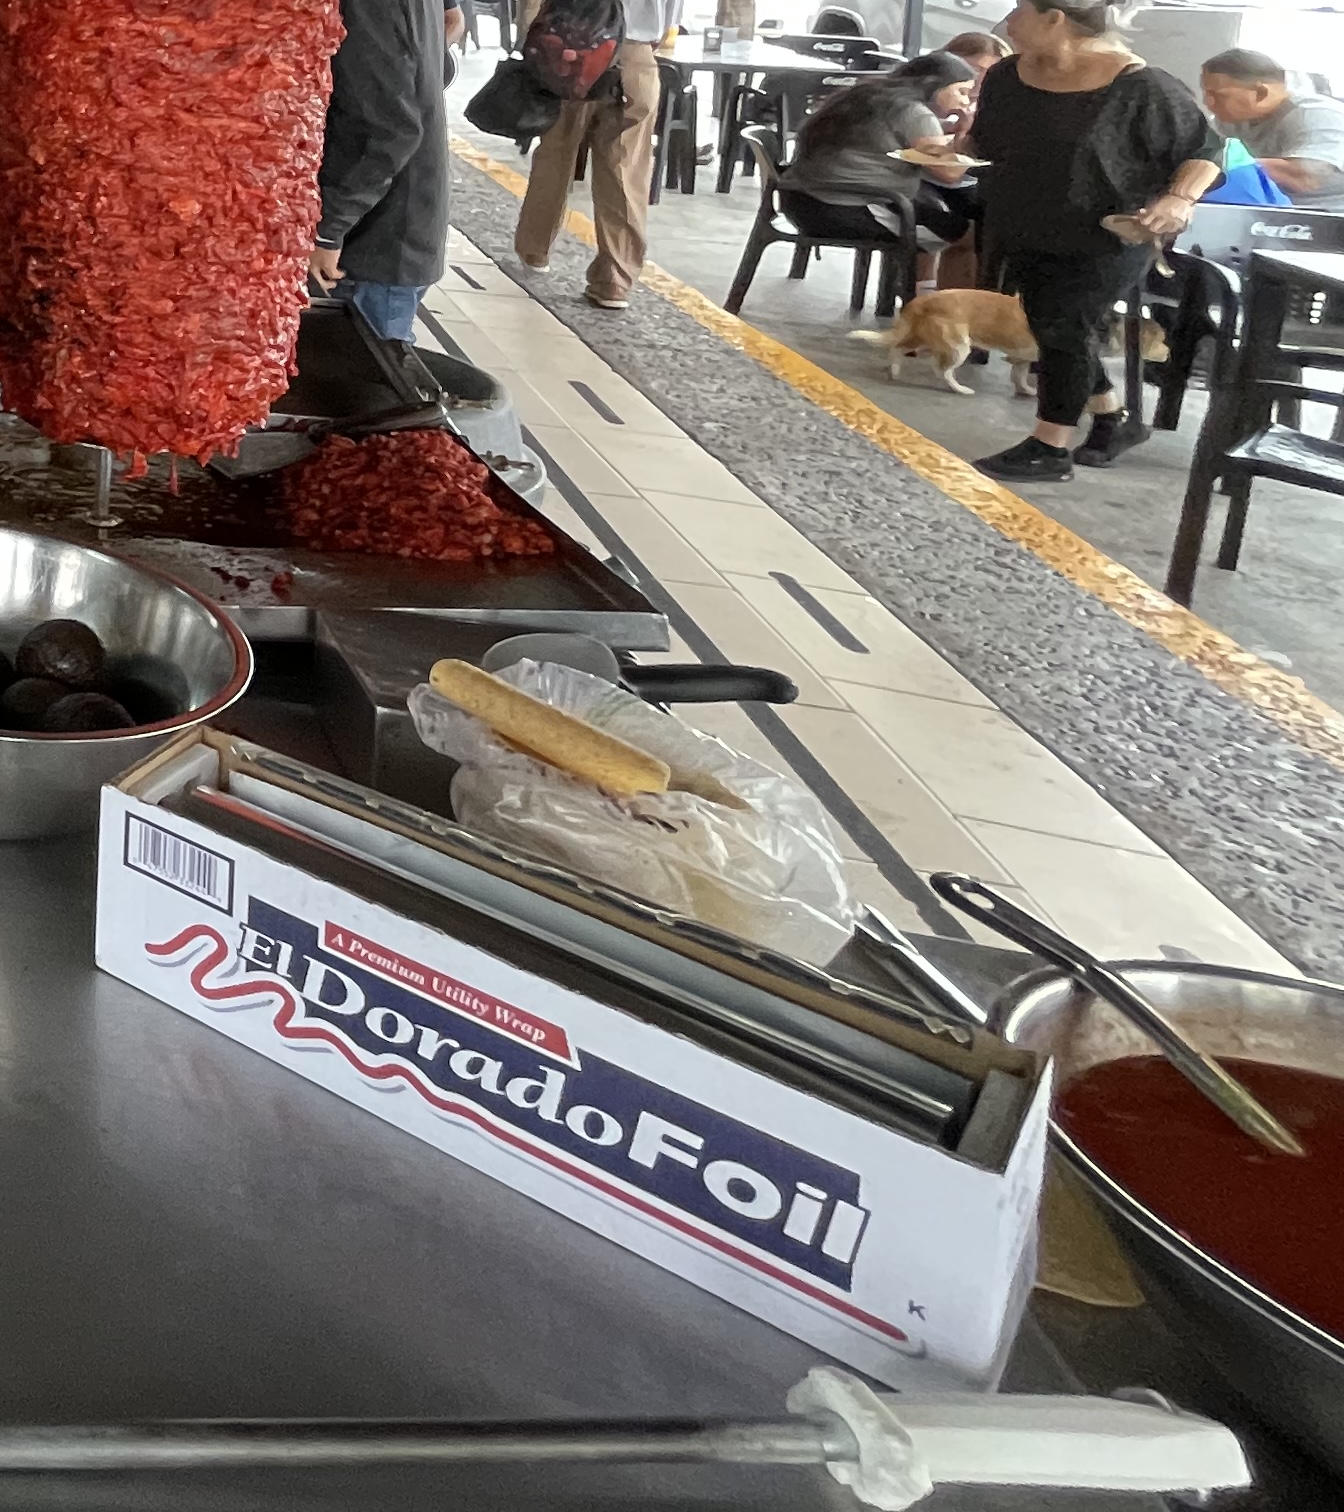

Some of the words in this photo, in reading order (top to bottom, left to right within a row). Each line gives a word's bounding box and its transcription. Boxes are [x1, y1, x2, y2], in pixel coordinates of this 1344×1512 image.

[330, 932, 346, 948] A
[349, 936, 426, 987] Premium
[431, 974, 491, 1023] Utility
[494, 1004, 548, 1045] Wrap
